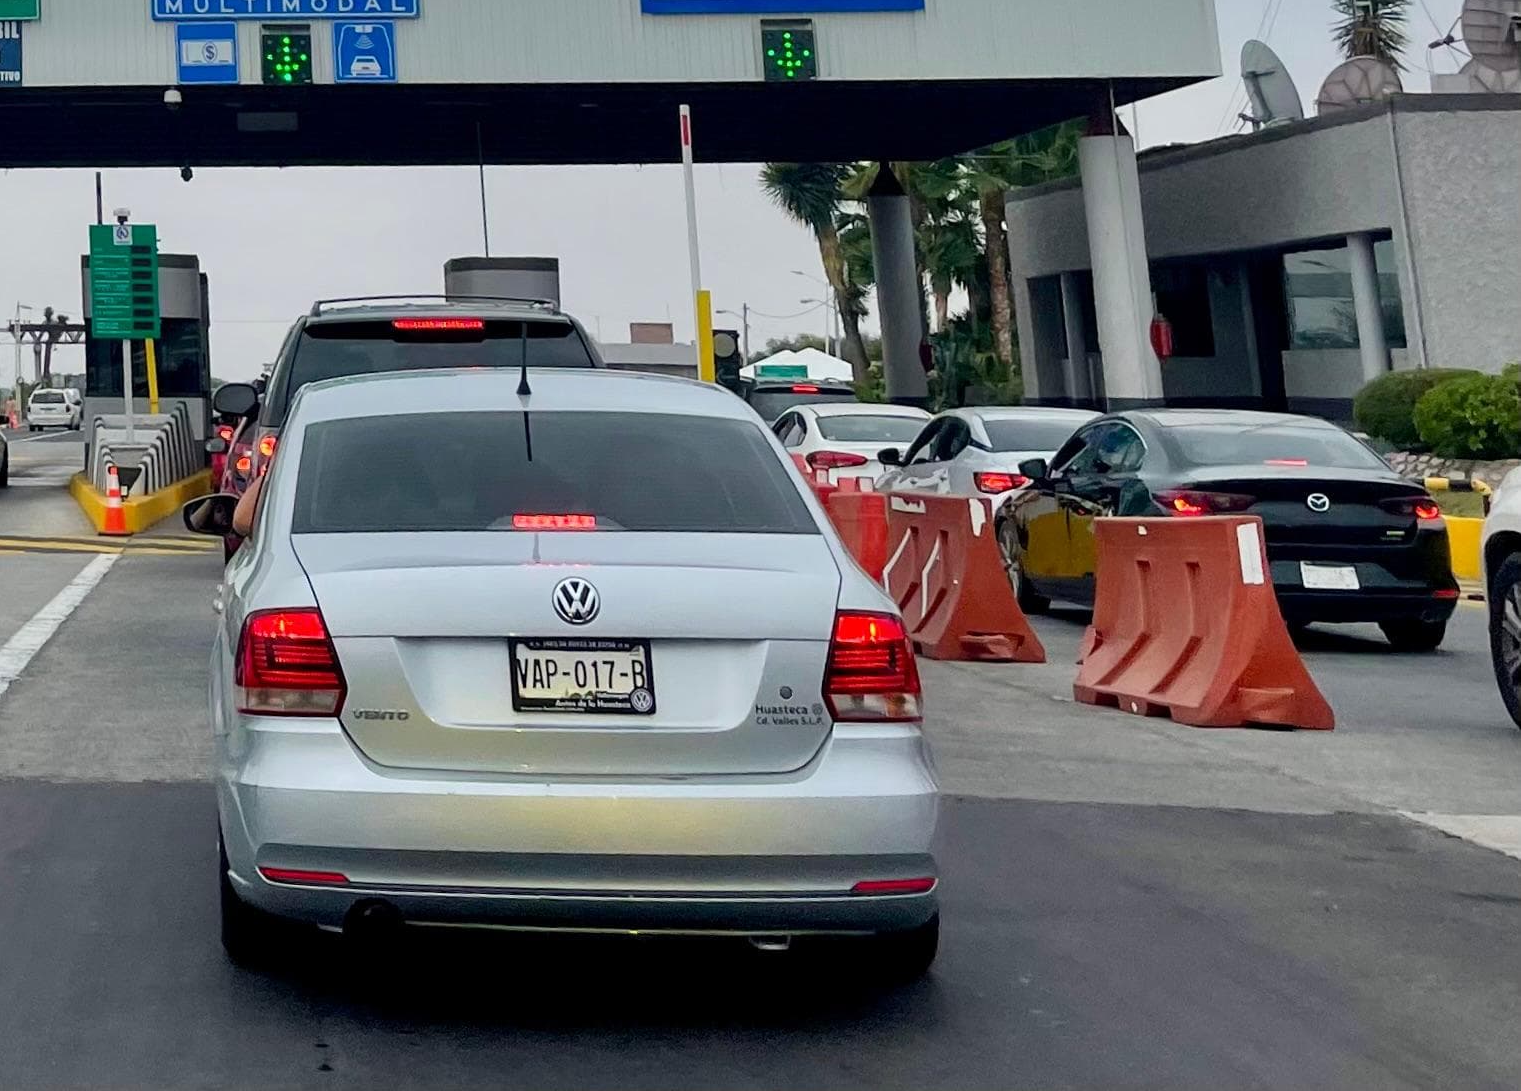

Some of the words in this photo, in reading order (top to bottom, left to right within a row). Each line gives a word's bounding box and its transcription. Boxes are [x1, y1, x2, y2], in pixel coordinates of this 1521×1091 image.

[516, 658, 646, 689] VAP-017-B
[755, 705, 808, 715] Huasteca
[772, 716, 799, 725] Valles
